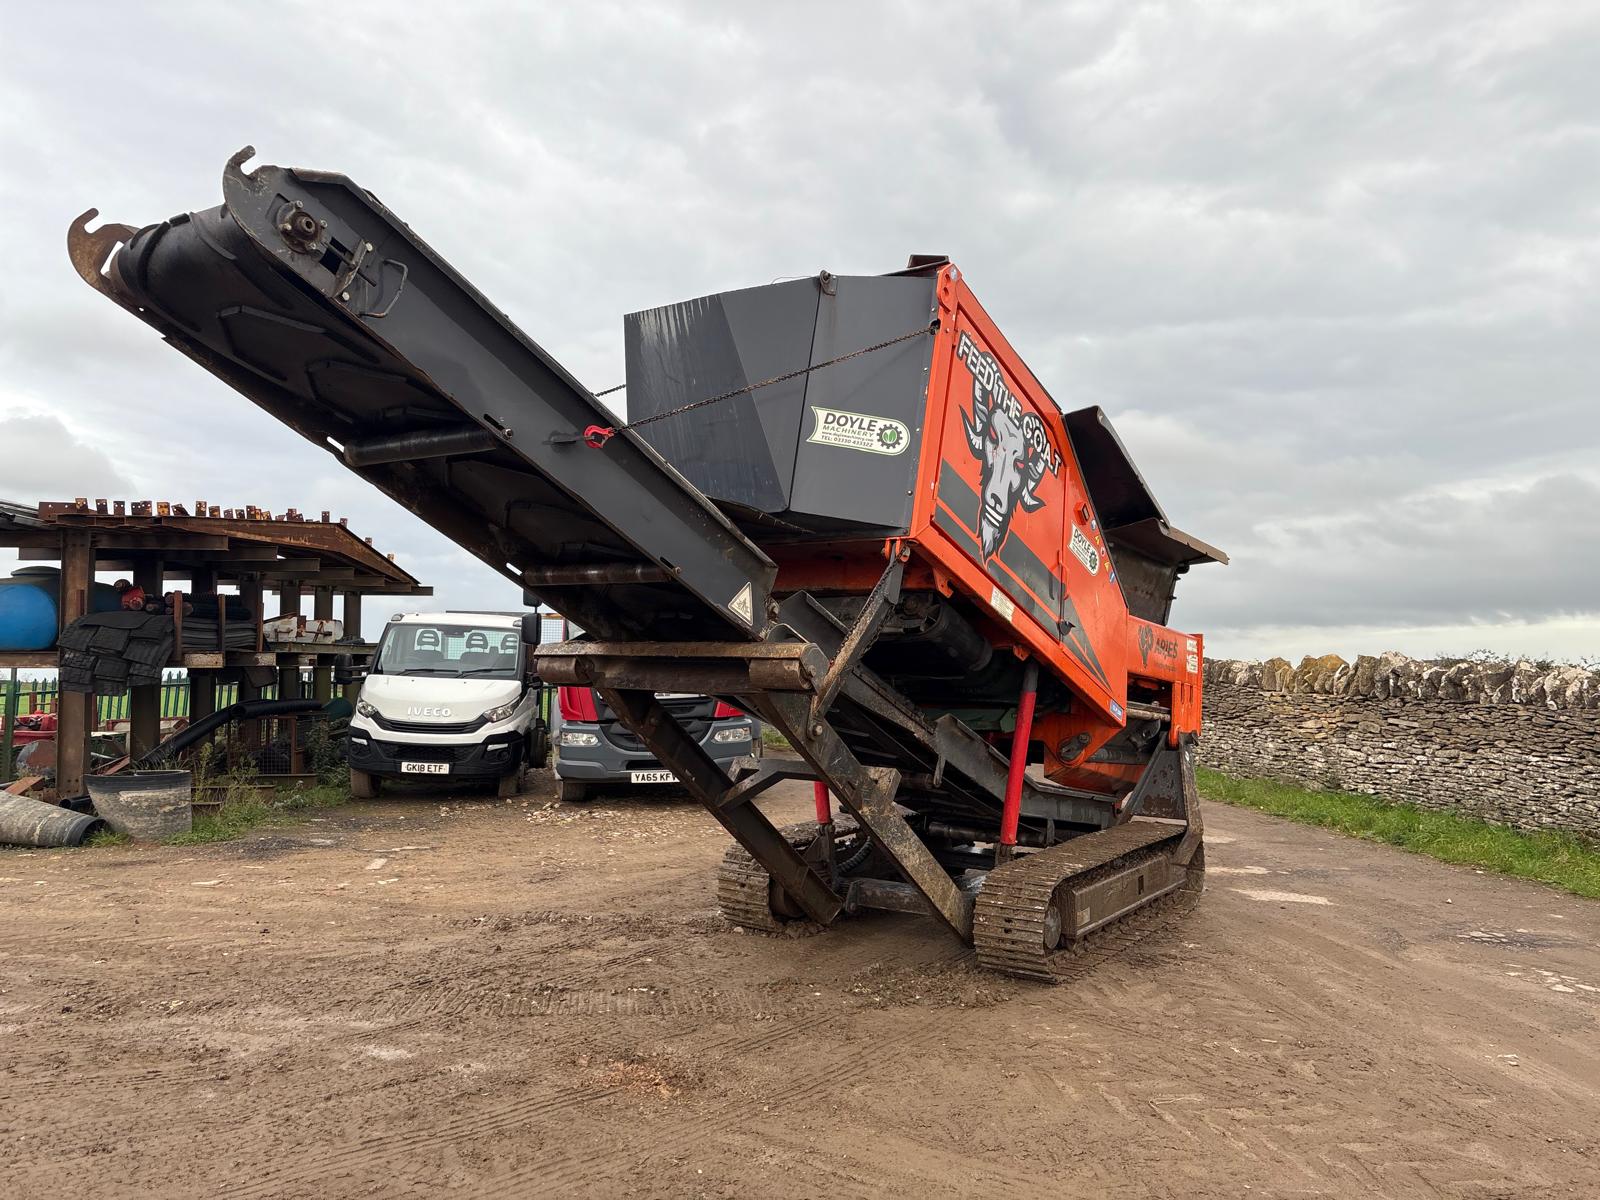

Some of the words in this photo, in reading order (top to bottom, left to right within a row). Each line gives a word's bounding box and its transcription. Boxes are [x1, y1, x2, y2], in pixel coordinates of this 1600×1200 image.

[958, 334, 995, 390] FEED
[995, 382, 1022, 426] THE
[824, 413, 878, 432] DOYLE
[822, 425, 874, 437] MACHINERY
[1074, 528, 1091, 553] DOYLE
[407, 706, 452, 717] IVECO
[406, 763, 426, 772] GK18
[427, 764, 444, 773] ETF
[635, 773, 658, 782] YA65
[659, 773, 677, 782] KF
